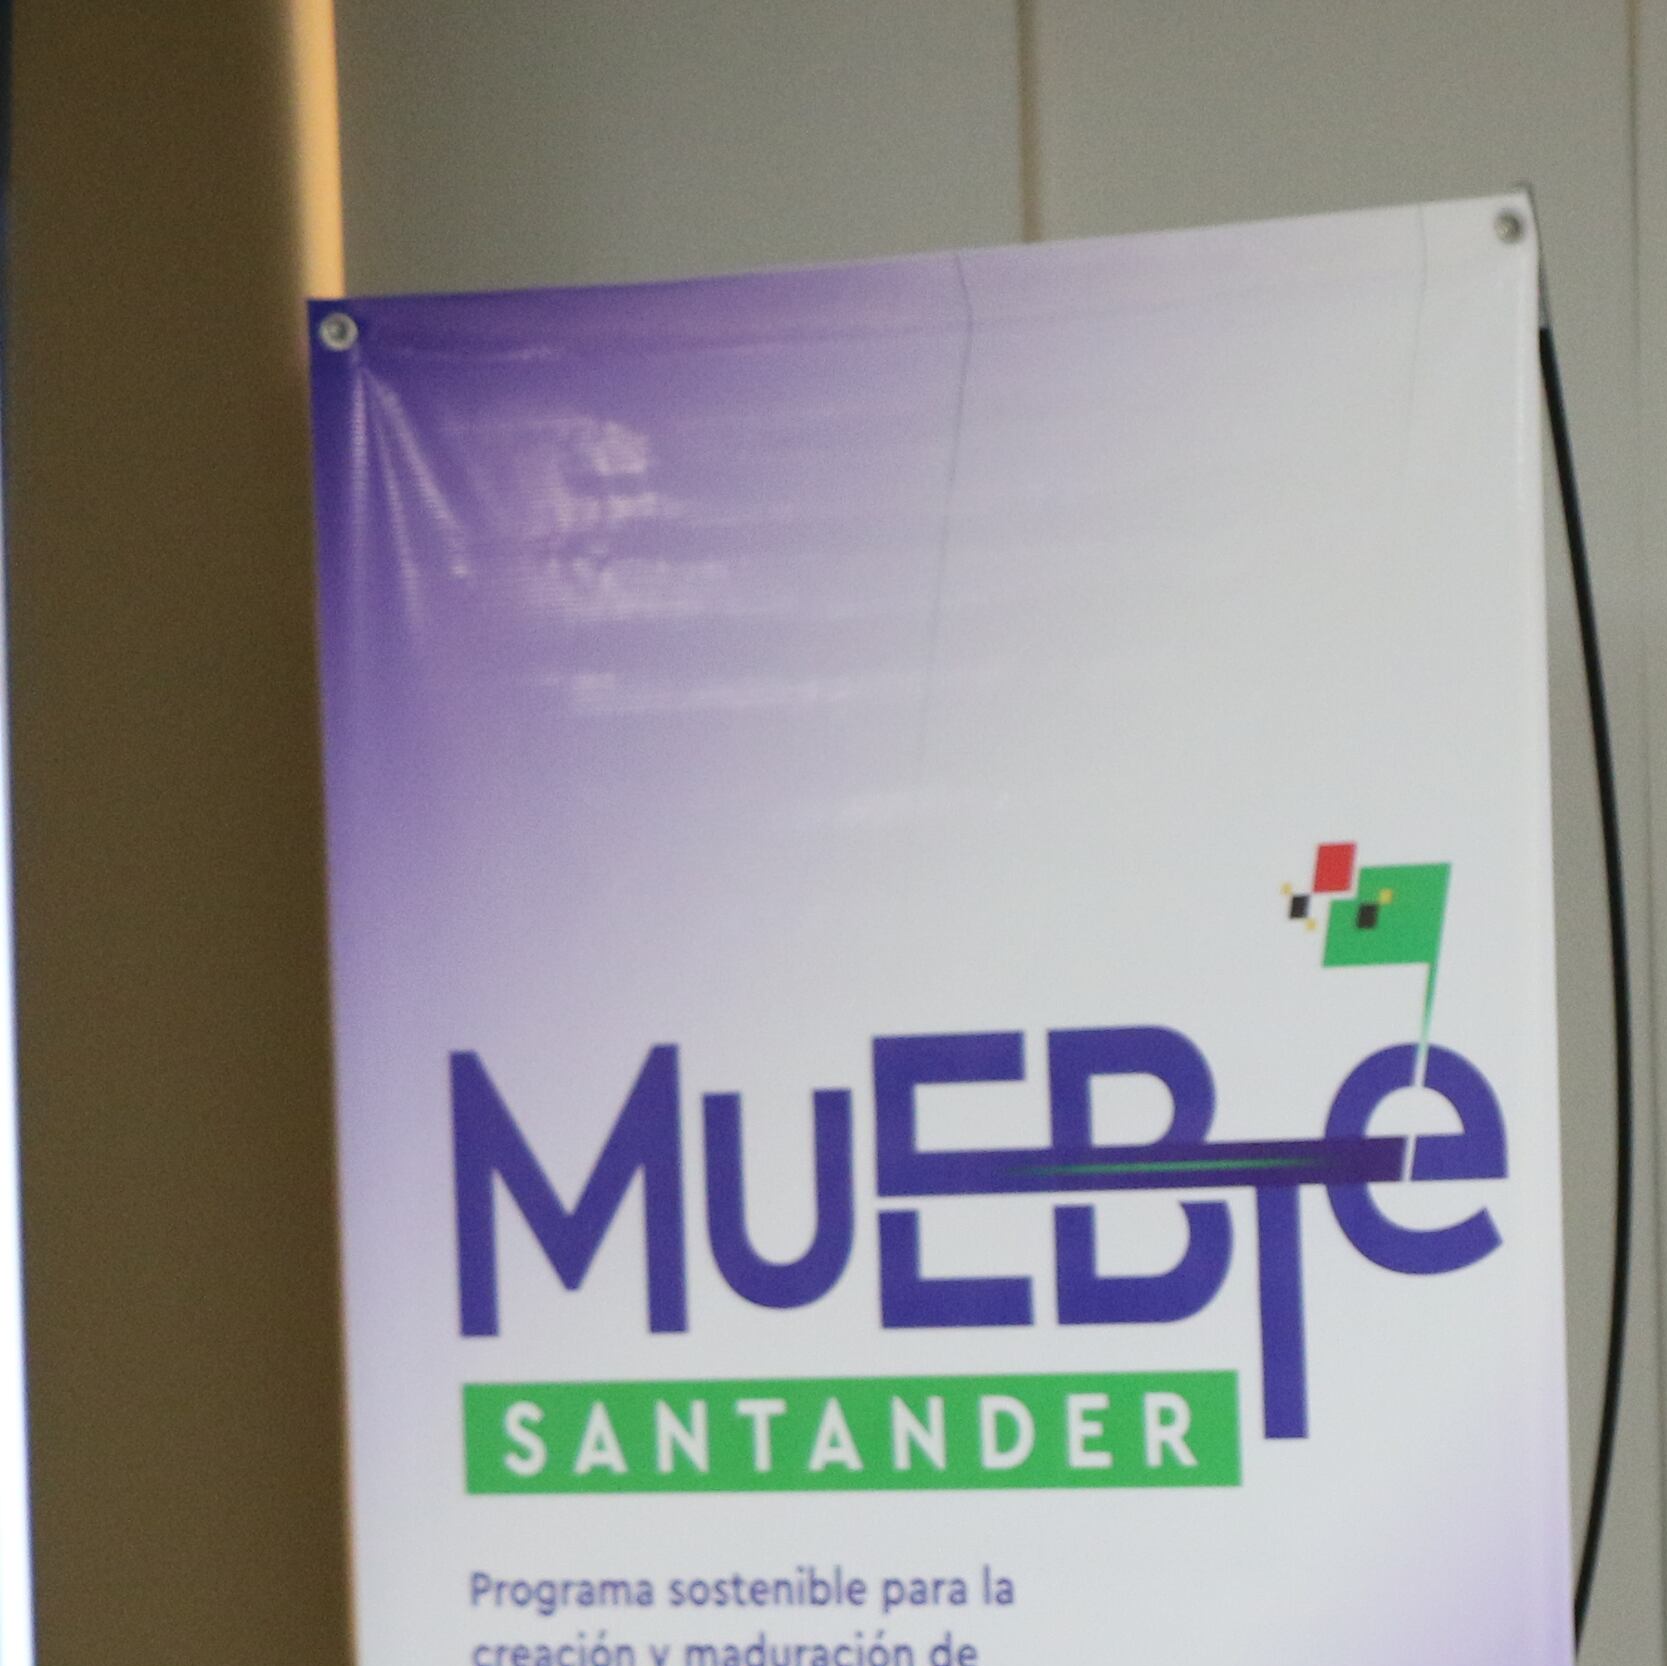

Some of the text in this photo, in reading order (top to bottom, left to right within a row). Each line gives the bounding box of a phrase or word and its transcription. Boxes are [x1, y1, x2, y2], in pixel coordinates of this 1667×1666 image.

[502, 1391, 1197, 1477] SANTANDER
[470, 1566, 1015, 1615] Programa sostenible para la
